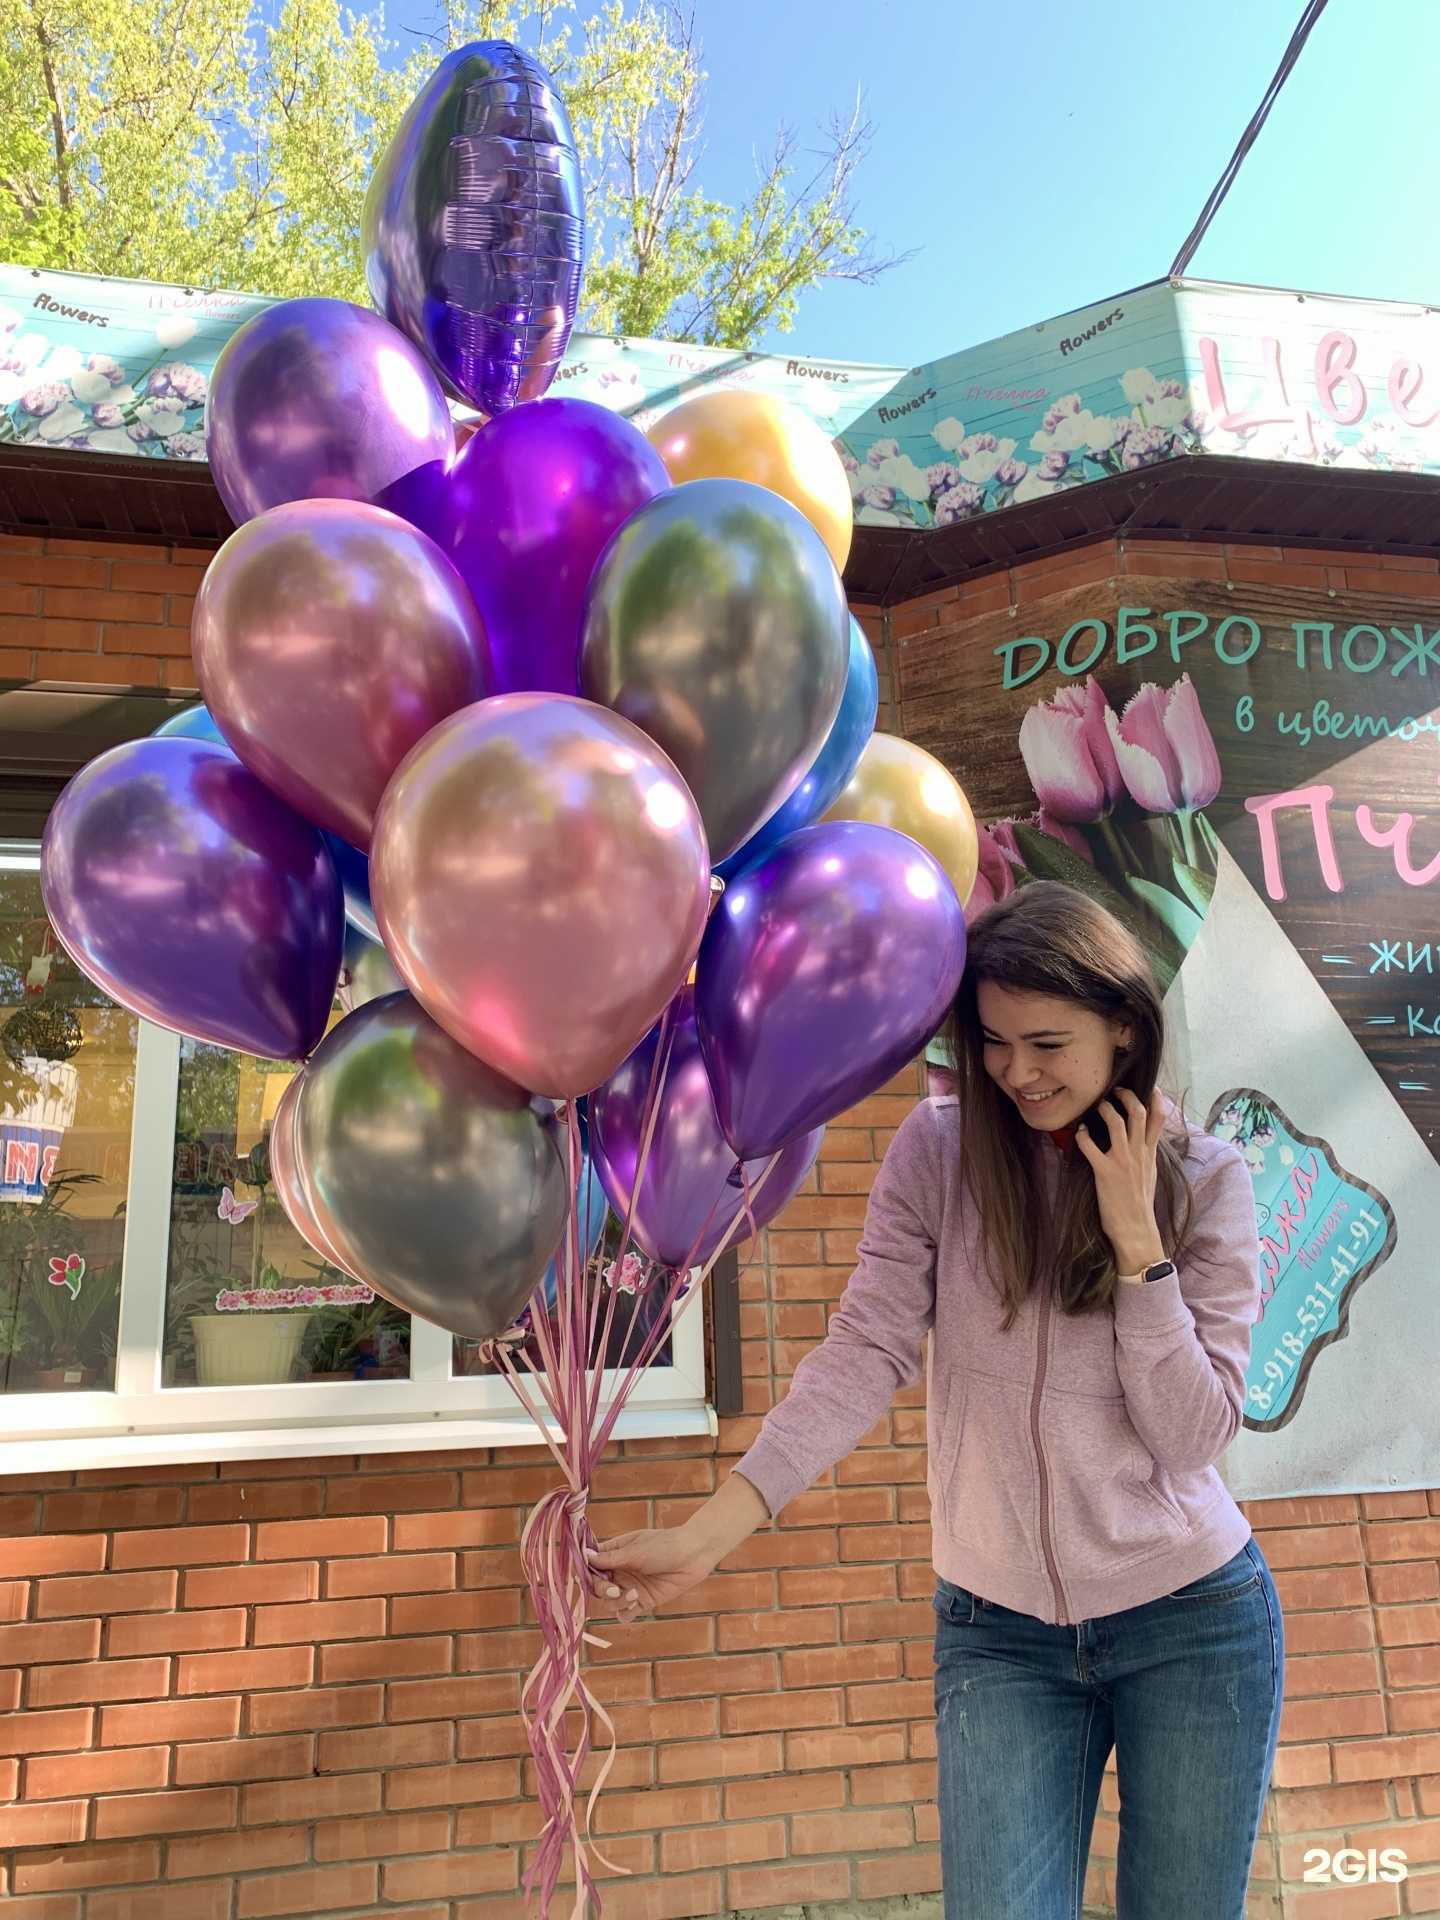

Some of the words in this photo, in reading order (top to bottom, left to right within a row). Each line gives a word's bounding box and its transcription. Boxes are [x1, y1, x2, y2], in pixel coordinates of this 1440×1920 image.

[33, 292, 110, 328] flowers
[1060, 307, 1124, 355] flowers
[552, 362, 589, 384] wers
[786, 359, 850, 384] flowers
[878, 387, 937, 424] flowers
[994, 607, 1262, 690] ДОБРО
[1244, 784, 1440, 902] Пч
[1297, 1197, 1350, 1272] flowers
[1249, 1208, 1381, 1410] 8-918-531-41-91
